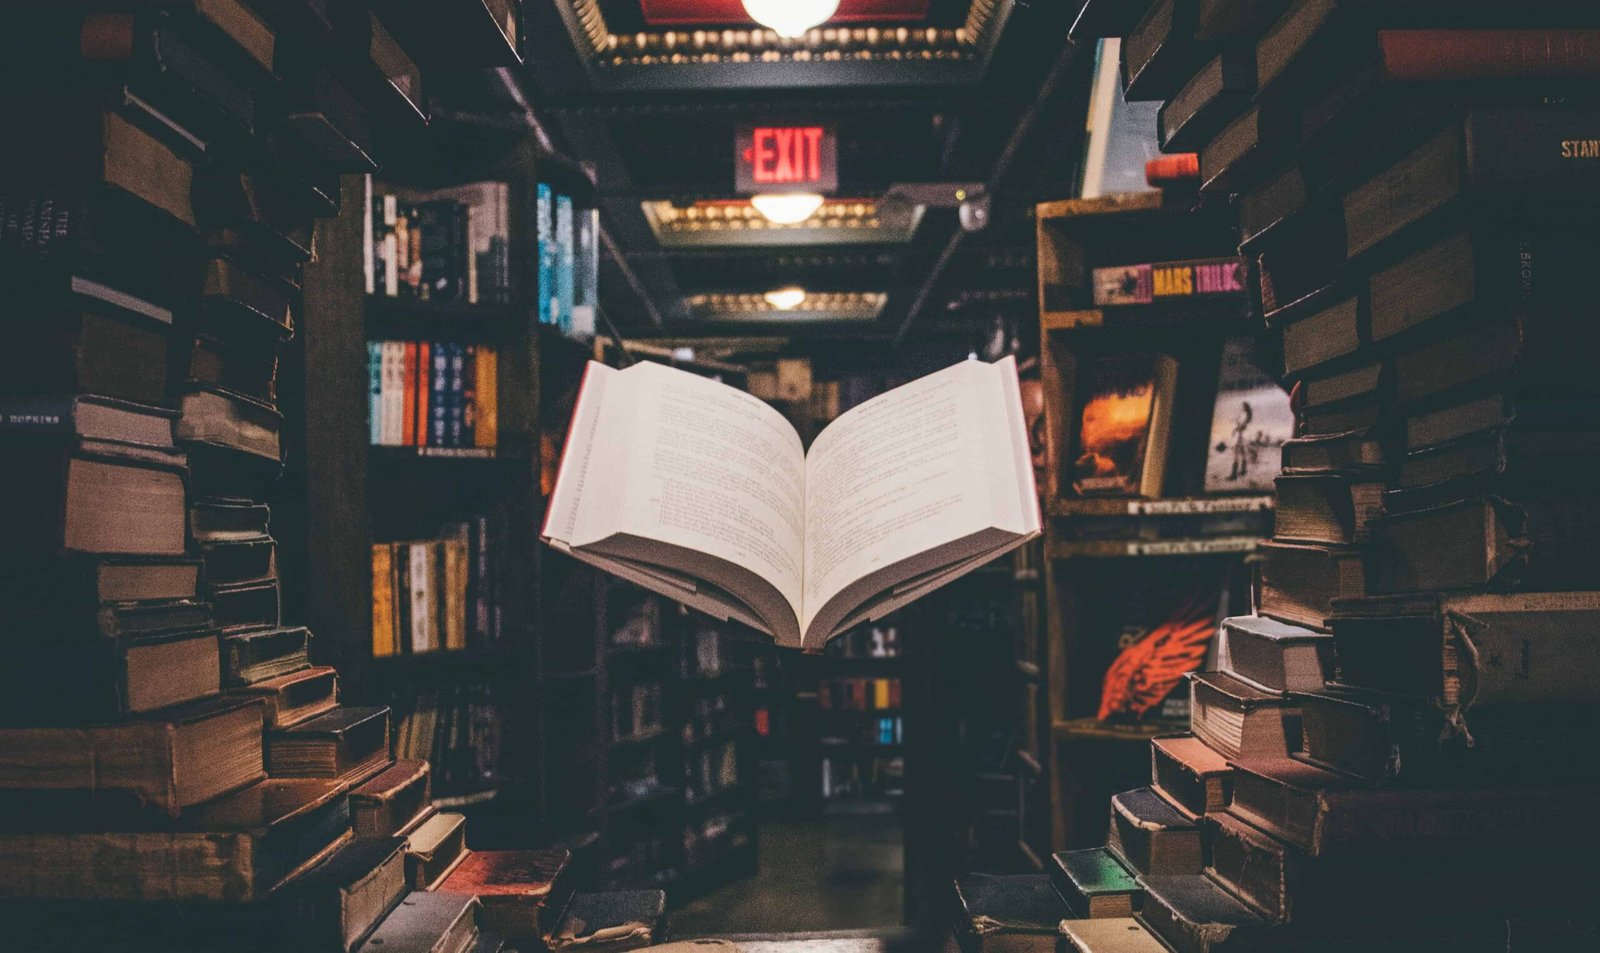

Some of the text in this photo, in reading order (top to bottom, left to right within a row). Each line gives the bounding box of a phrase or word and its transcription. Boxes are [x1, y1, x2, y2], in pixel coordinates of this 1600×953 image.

[753, 126, 824, 182] EXIT
[1561, 140, 1600, 158] STAN
[1153, 266, 1193, 296] MARS
